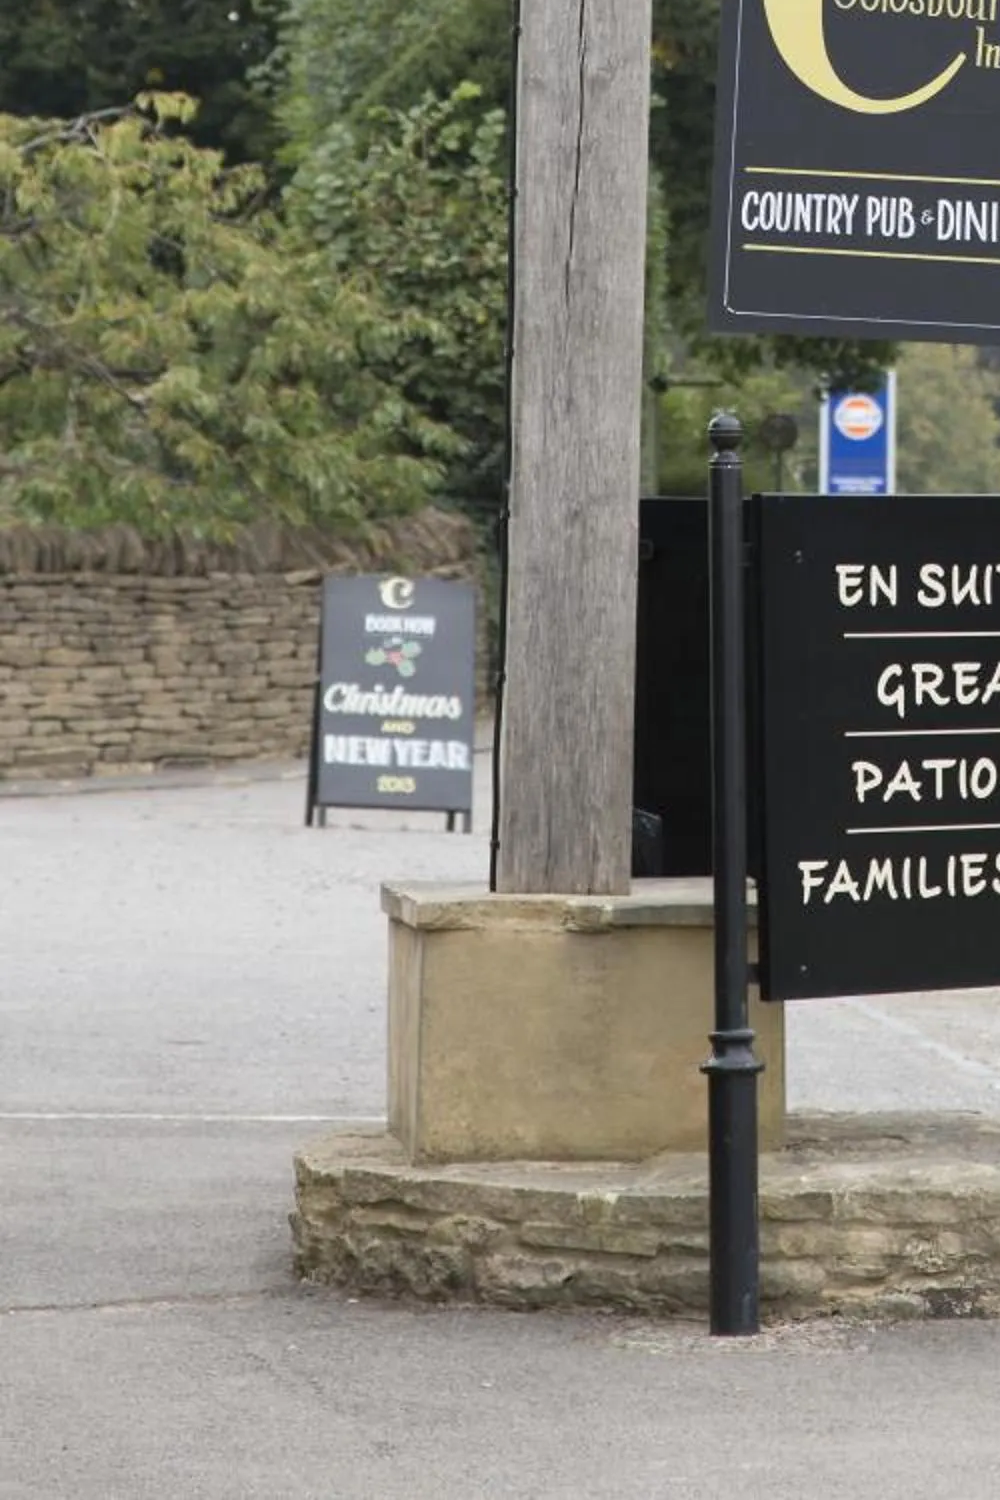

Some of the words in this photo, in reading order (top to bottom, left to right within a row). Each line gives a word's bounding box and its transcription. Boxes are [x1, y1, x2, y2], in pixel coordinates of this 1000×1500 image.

[741, 190, 856, 236] COUNTRY
[866, 196, 916, 238] PUB
[920, 207, 935, 226] &
[835, 563, 897, 607] EN
[323, 682, 462, 719] Christmas
[323, 734, 391, 767] NEW
[393, 738, 471, 770] YEAR
[852, 756, 998, 803] PATIO
